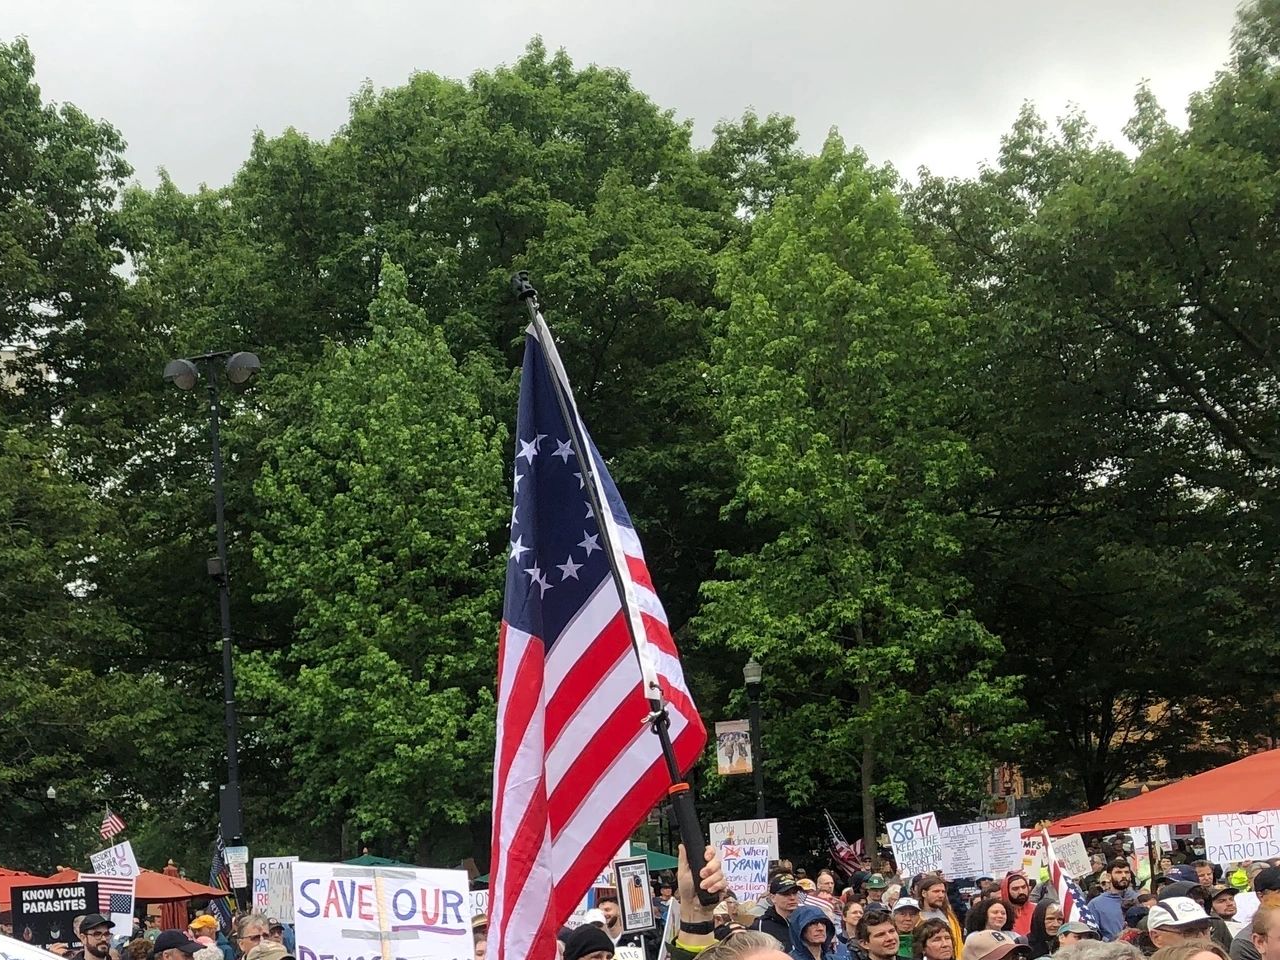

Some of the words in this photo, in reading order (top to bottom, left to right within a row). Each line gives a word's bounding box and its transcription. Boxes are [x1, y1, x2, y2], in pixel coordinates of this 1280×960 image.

[891, 815, 933, 844] 8647
[1247, 824, 1275, 841] NOT
[22, 888, 54, 901] KNOW
[56, 886, 86, 899] YOUR
[297, 878, 375, 921] SAVE
[392, 888, 465, 926] OUR
[22, 899, 87, 914] PARASITES
